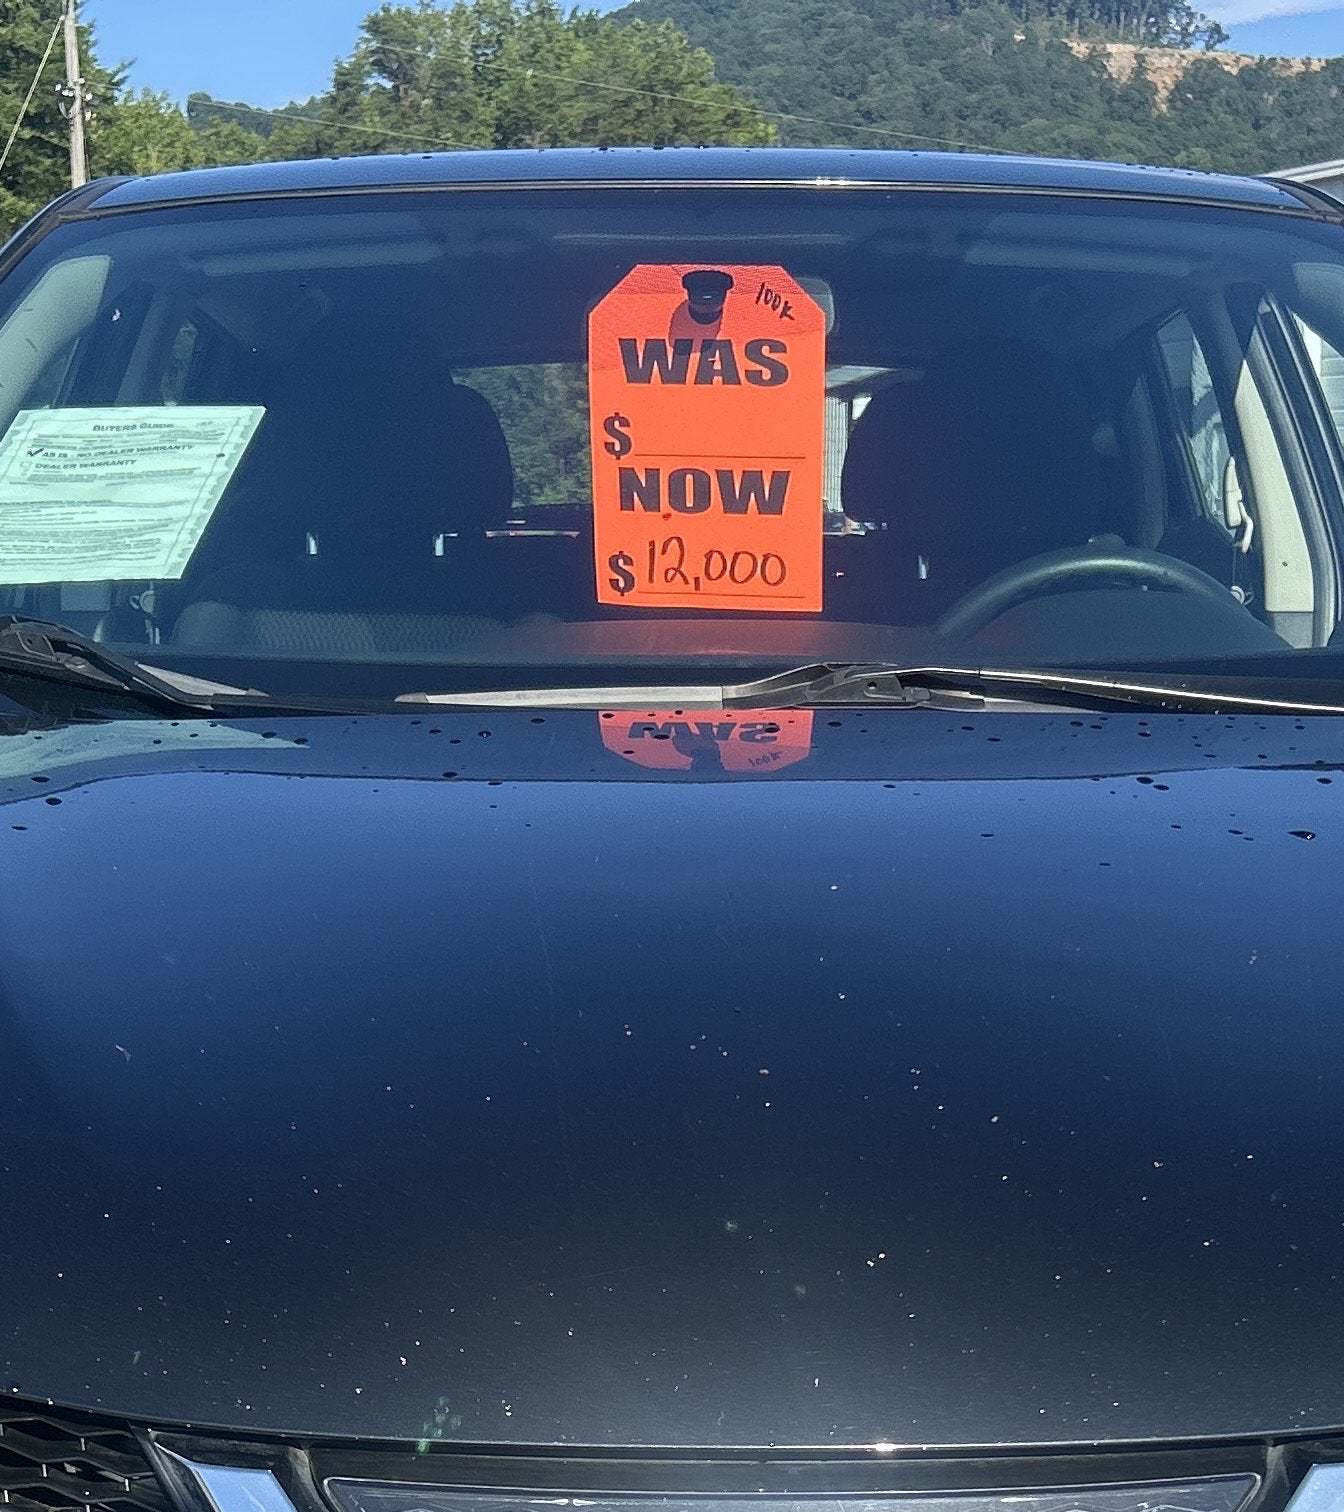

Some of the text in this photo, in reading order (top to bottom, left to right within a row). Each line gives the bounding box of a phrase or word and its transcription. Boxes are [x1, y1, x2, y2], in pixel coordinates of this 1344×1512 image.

[618, 338, 790, 387] WAS
[603, 412, 633, 460] $
[618, 466, 791, 516] NOW
